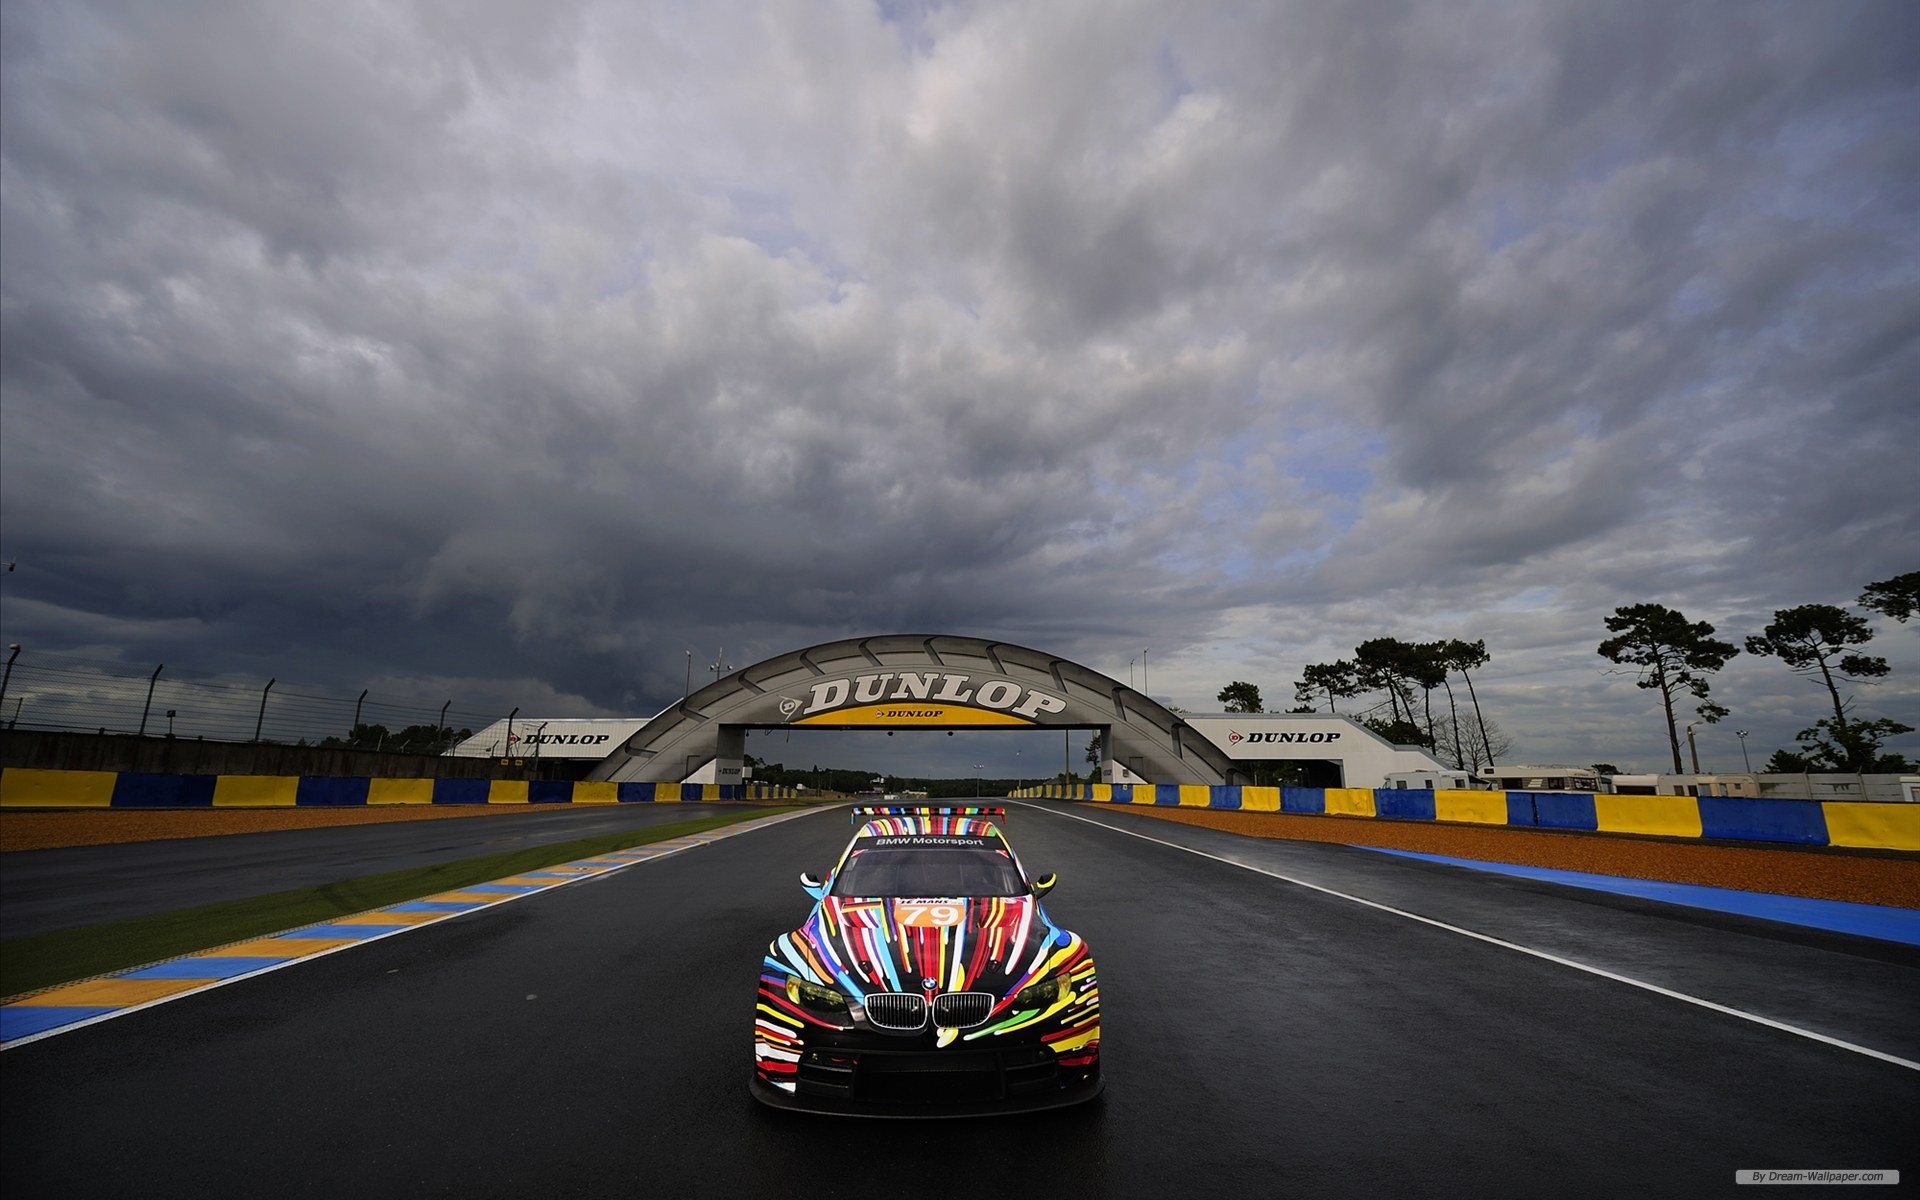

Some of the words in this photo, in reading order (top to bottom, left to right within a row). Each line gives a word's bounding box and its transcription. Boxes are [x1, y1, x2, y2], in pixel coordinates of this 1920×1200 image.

[803, 672, 1067, 719] DUNLOP
[887, 710, 943, 718] DUNLOP
[523, 735, 609, 744] DUNLOP
[1247, 733, 1341, 743] DUNLOP
[901, 906, 959, 925] 79
